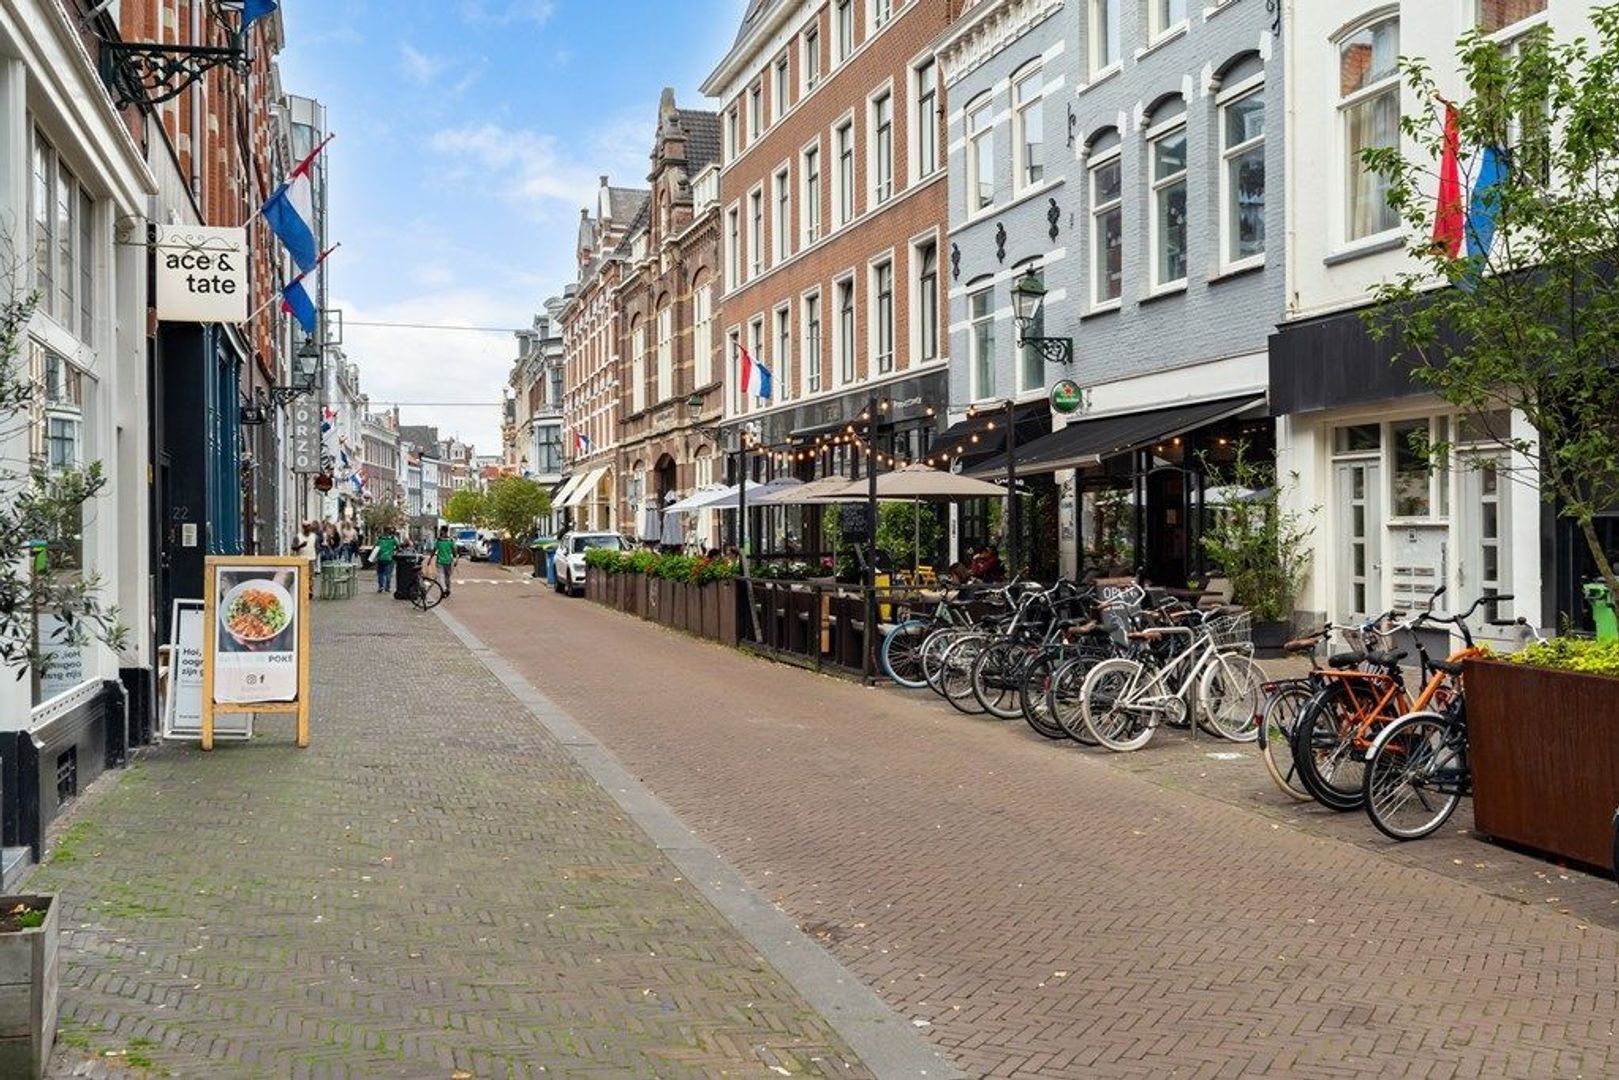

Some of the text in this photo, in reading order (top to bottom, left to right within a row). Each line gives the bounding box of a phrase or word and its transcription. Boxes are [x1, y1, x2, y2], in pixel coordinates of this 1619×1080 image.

[166, 253, 235, 271] ace &
[186, 274, 236, 294] tate
[296, 394, 309, 467] KORZO
[172, 506, 189, 520] 22
[183, 648, 202, 657] Hoi,
[182, 667, 198, 677] zijn
